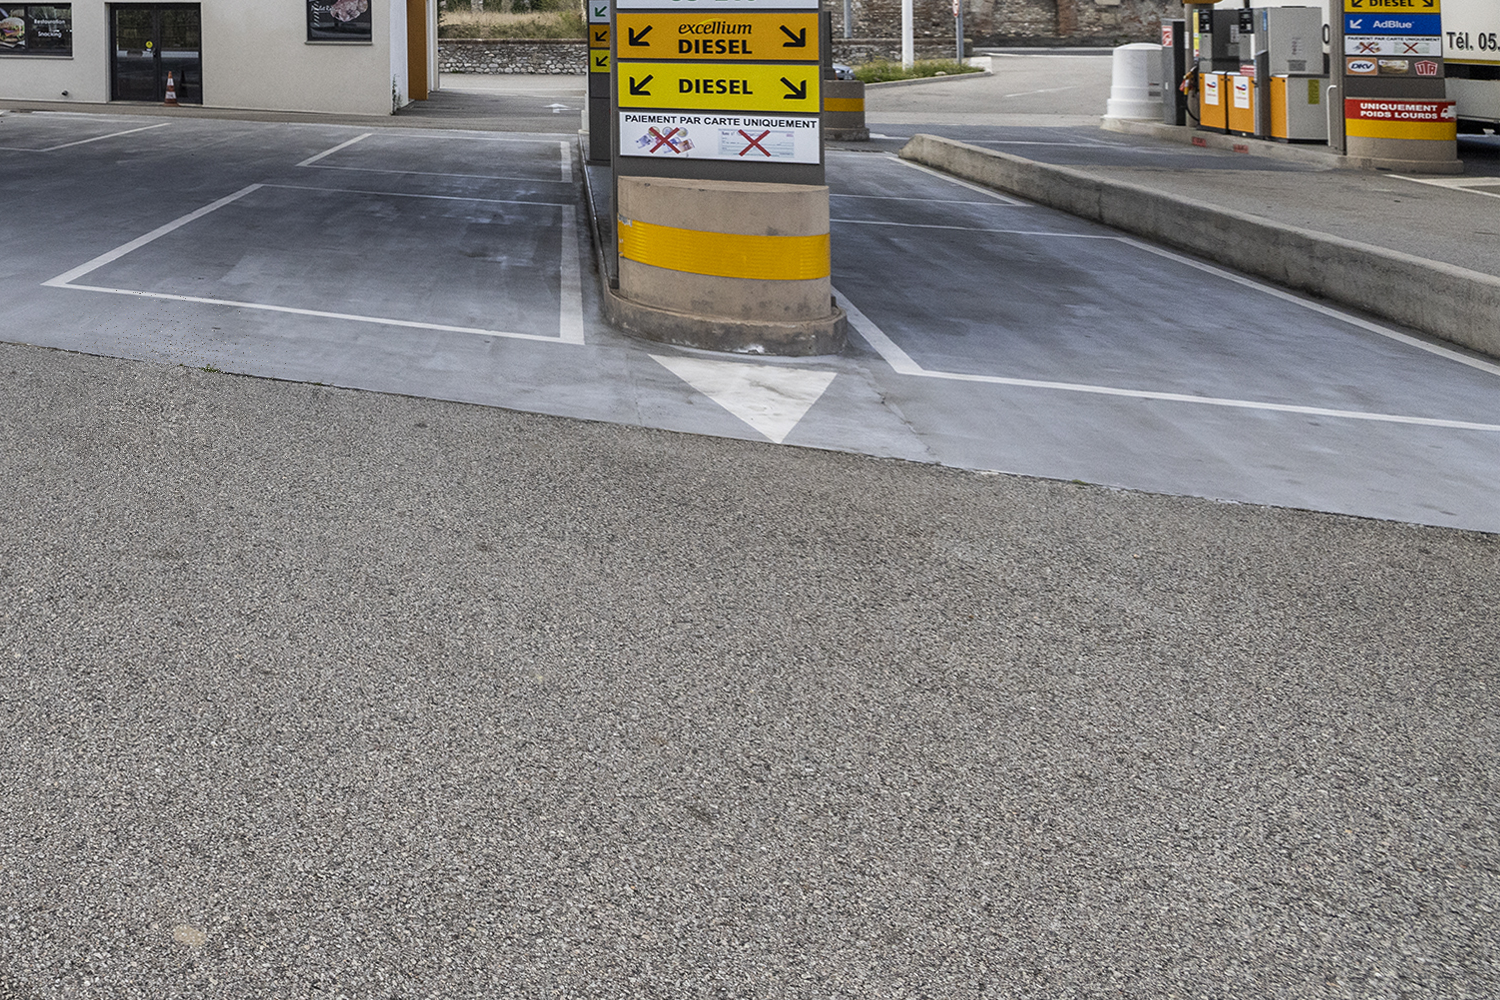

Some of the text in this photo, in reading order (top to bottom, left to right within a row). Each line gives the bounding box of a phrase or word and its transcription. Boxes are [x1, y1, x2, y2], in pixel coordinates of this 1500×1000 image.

[678, 20, 752, 35] excellium
[1373, 20, 1412, 29] AdBlue
[678, 39, 753, 54] DIESEL
[1446, 31, 1473, 51] Tél.
[678, 79, 753, 95] DIESEL
[1360, 103, 1438, 112] UNIQUEMENT
[625, 115, 817, 129] PAIEMENT PAR CARTE UNIQUEMENT
[1394, 112, 1438, 120] LOURDS
